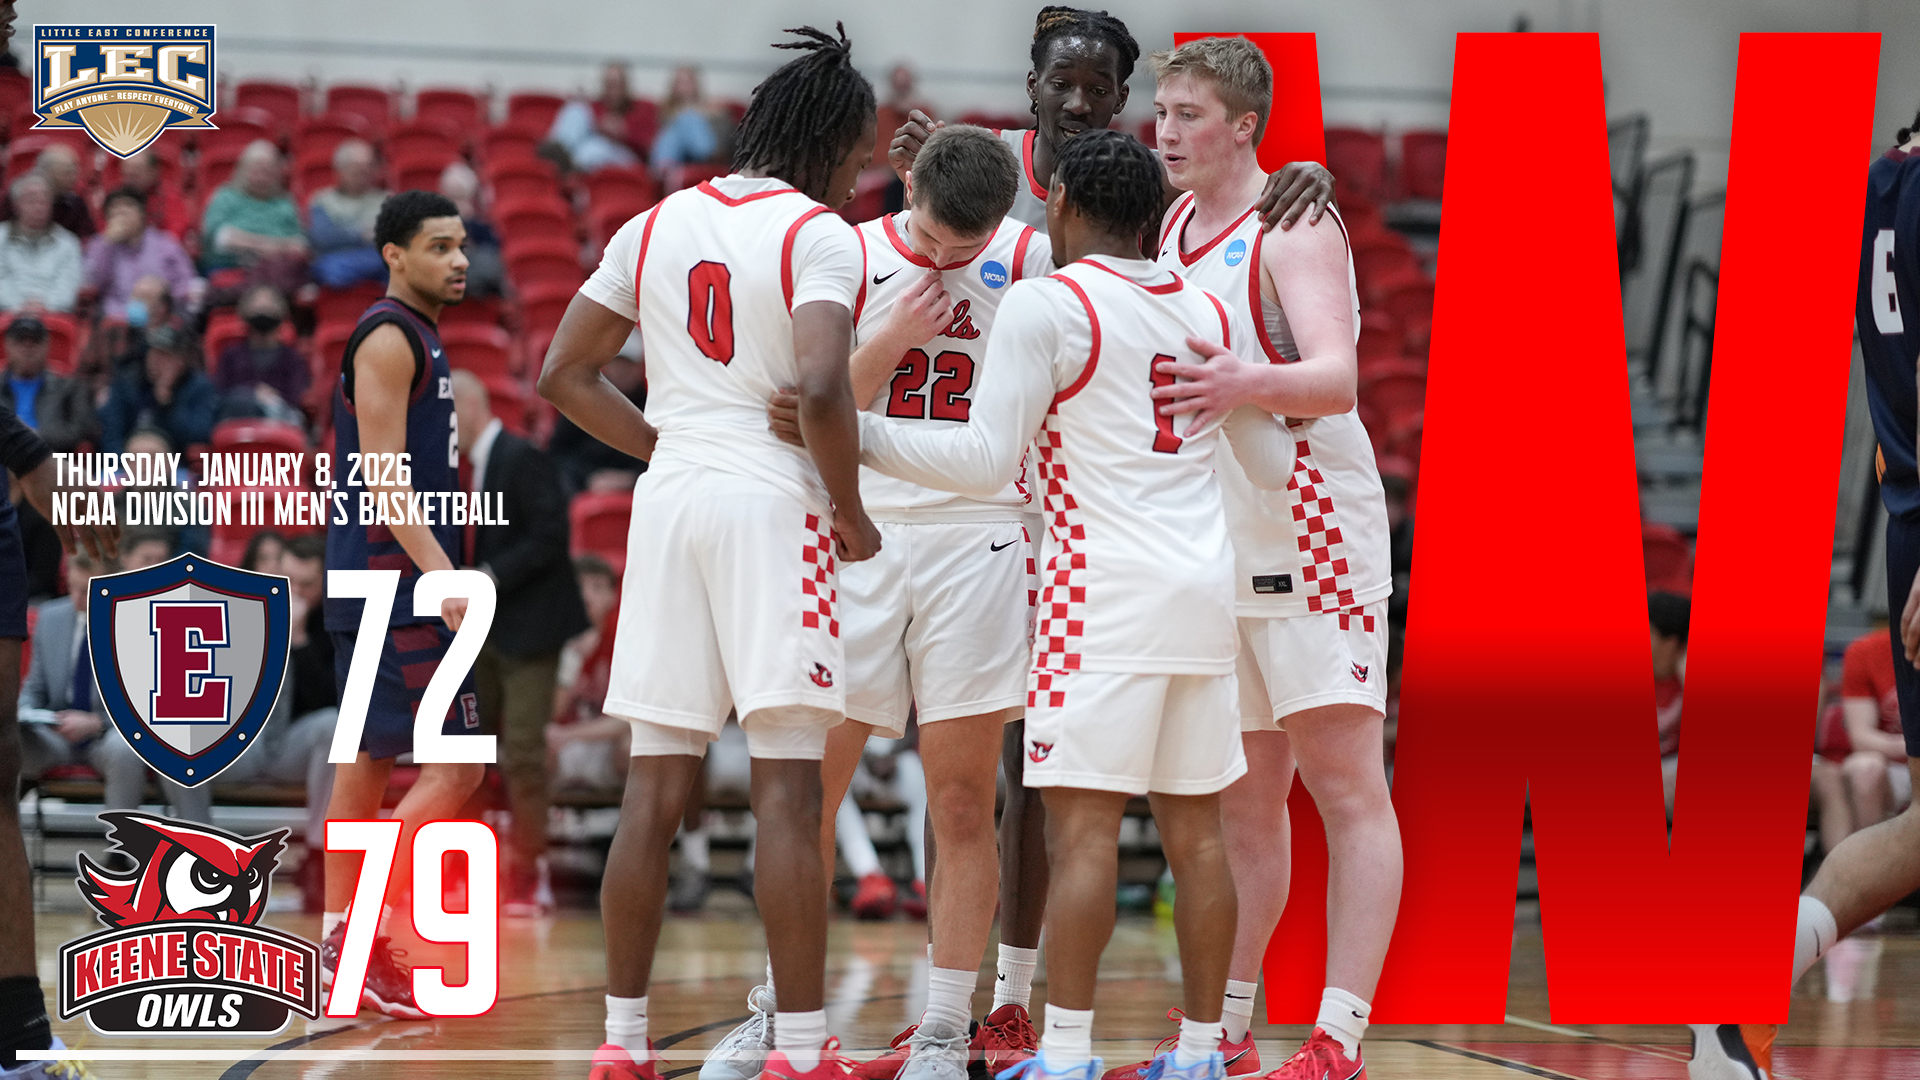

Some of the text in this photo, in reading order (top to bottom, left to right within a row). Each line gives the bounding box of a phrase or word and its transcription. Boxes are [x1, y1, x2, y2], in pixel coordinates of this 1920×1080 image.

[984, 271, 1006, 283] NCAA
[937, 298, 982, 340] ls
[886, 348, 976, 423] 22
